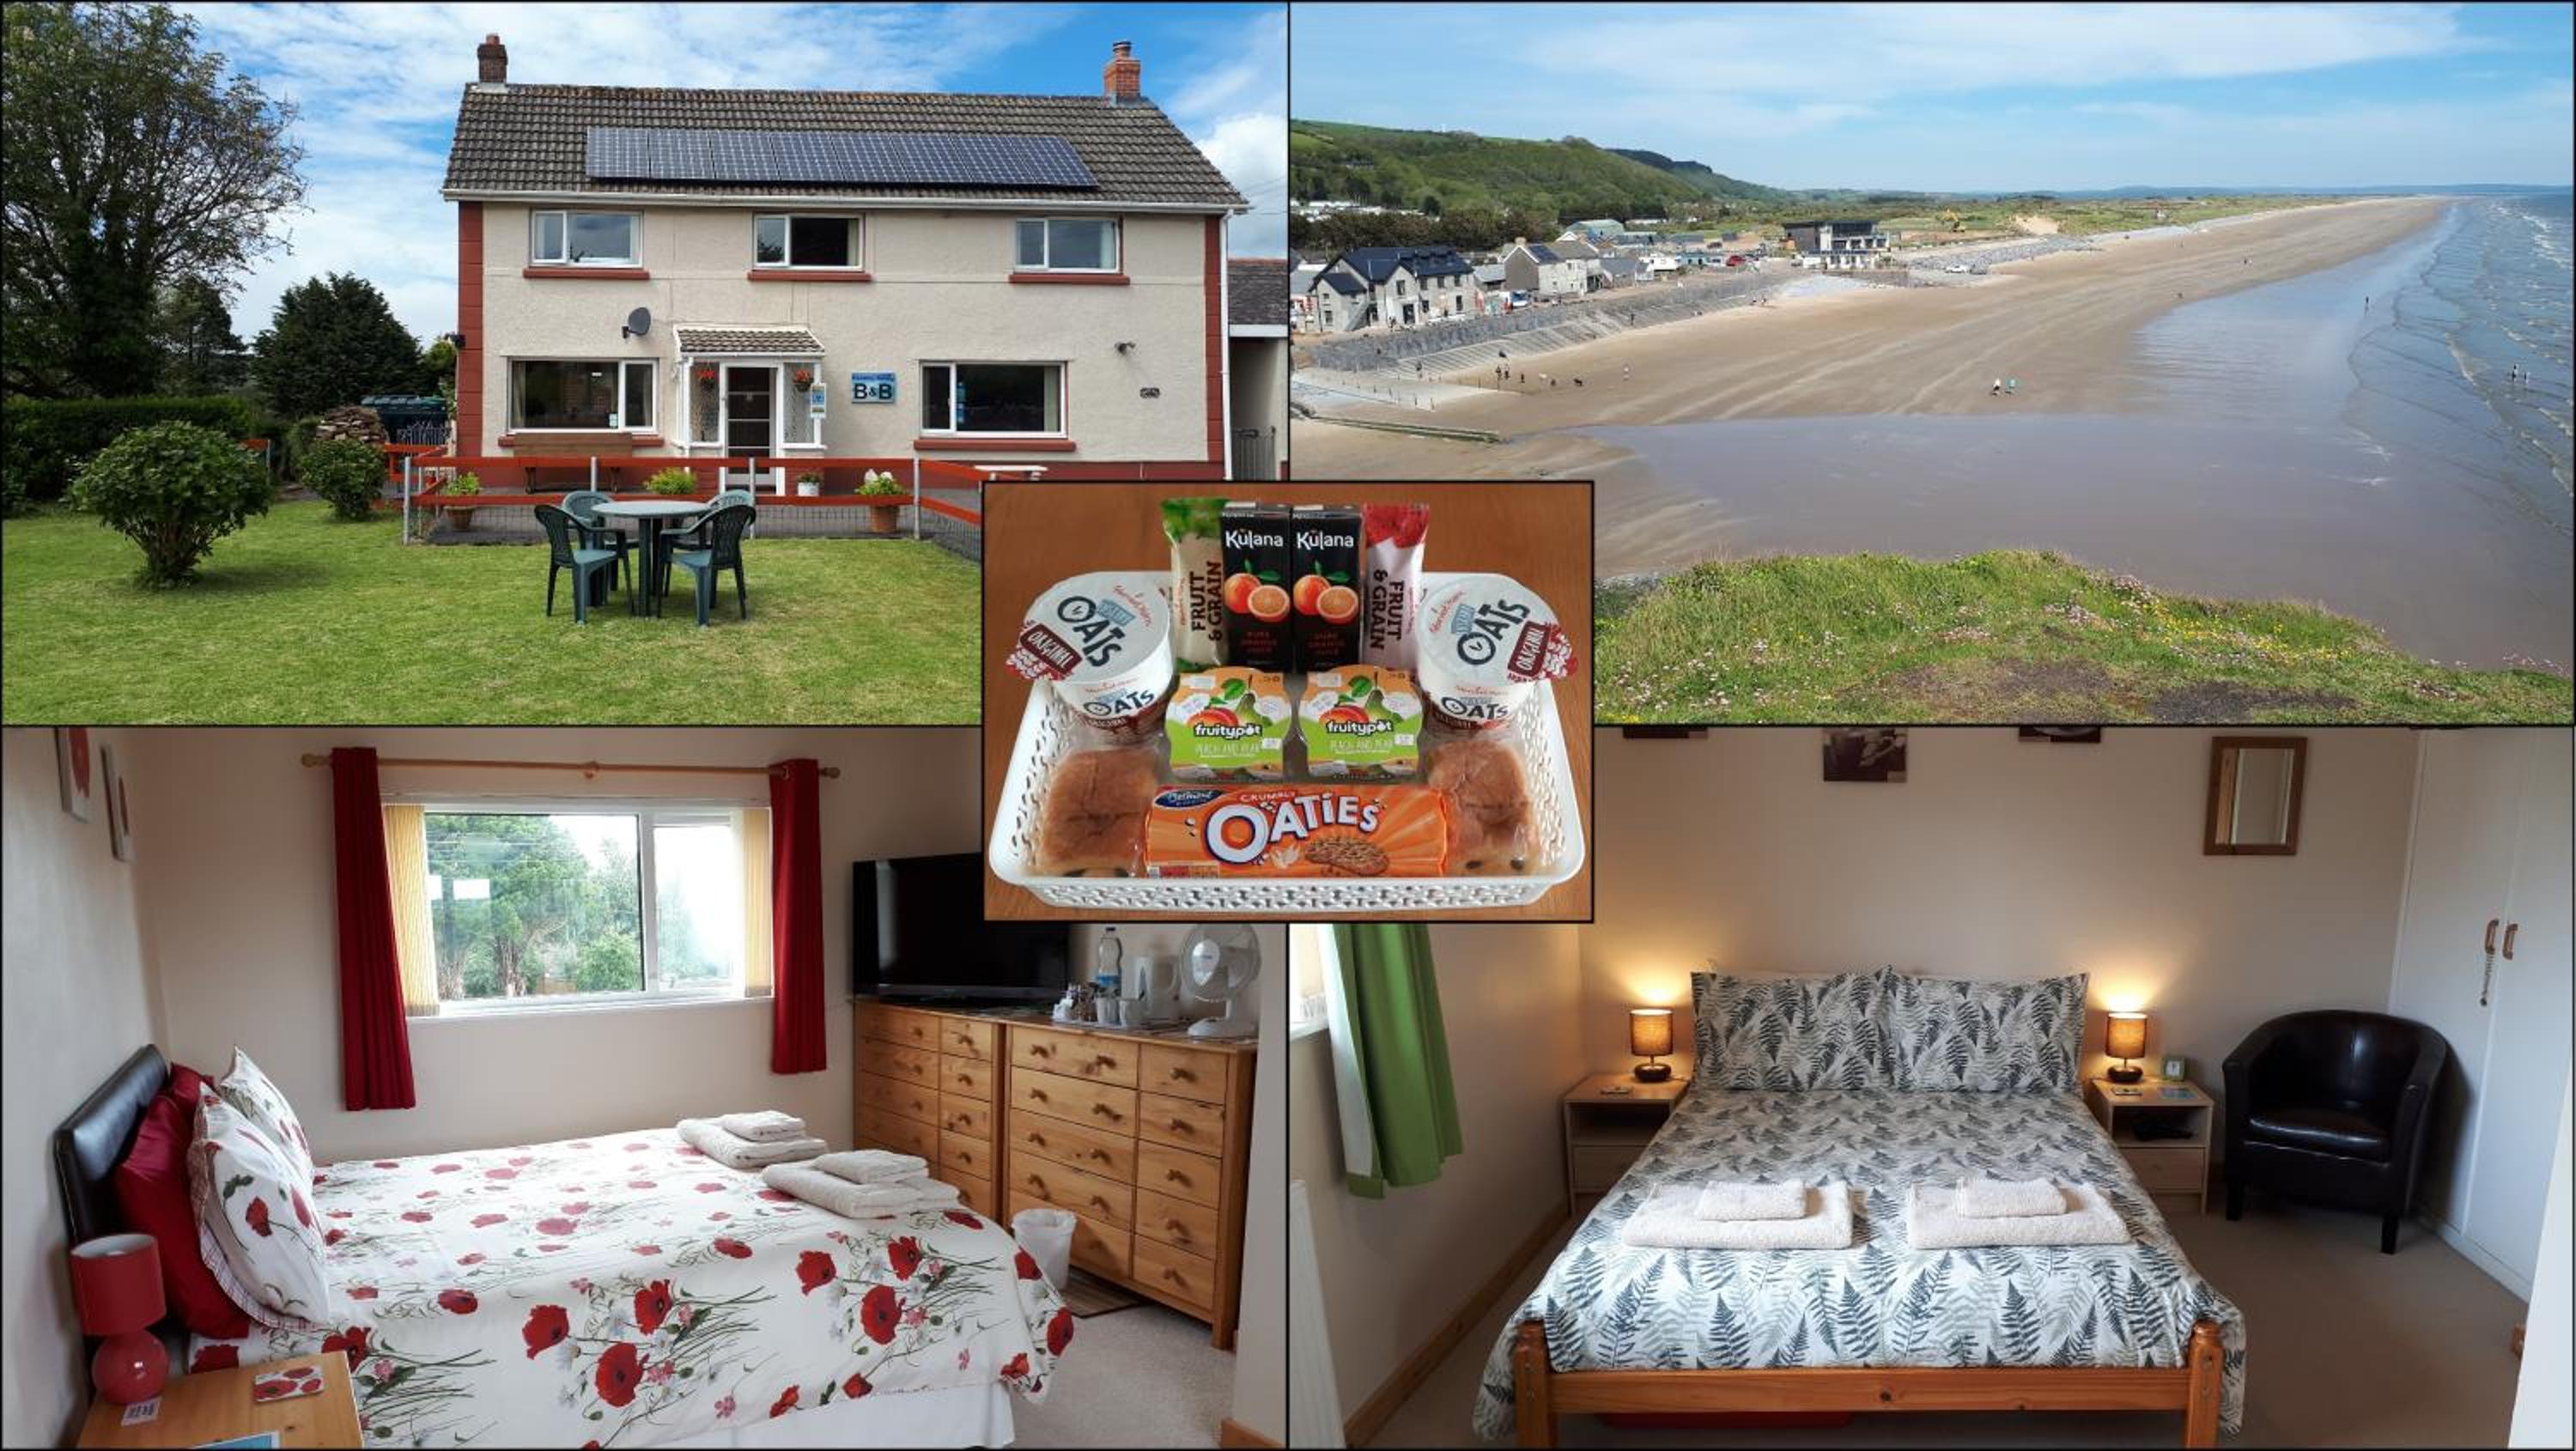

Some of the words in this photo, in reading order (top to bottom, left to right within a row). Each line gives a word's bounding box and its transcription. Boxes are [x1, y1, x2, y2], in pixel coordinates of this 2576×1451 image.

[854, 384, 892, 399] B&B
[1374, 569, 1388, 581] &
[1190, 571, 1206, 632] FRUIT
[1206, 561, 1222, 626] GRAIN
[1370, 586, 1387, 651] GRAIN
[1388, 580, 1405, 641] FRUIT
[1057, 596, 1126, 667] OATS
[1208, 629, 1223, 641] &
[1457, 599, 1530, 665] OATS
[1083, 689, 1155, 716] OATS
[1441, 696, 1509, 719] OATS
[1194, 723, 1261, 739] fruitypot
[1327, 720, 1392, 736] fruitypot
